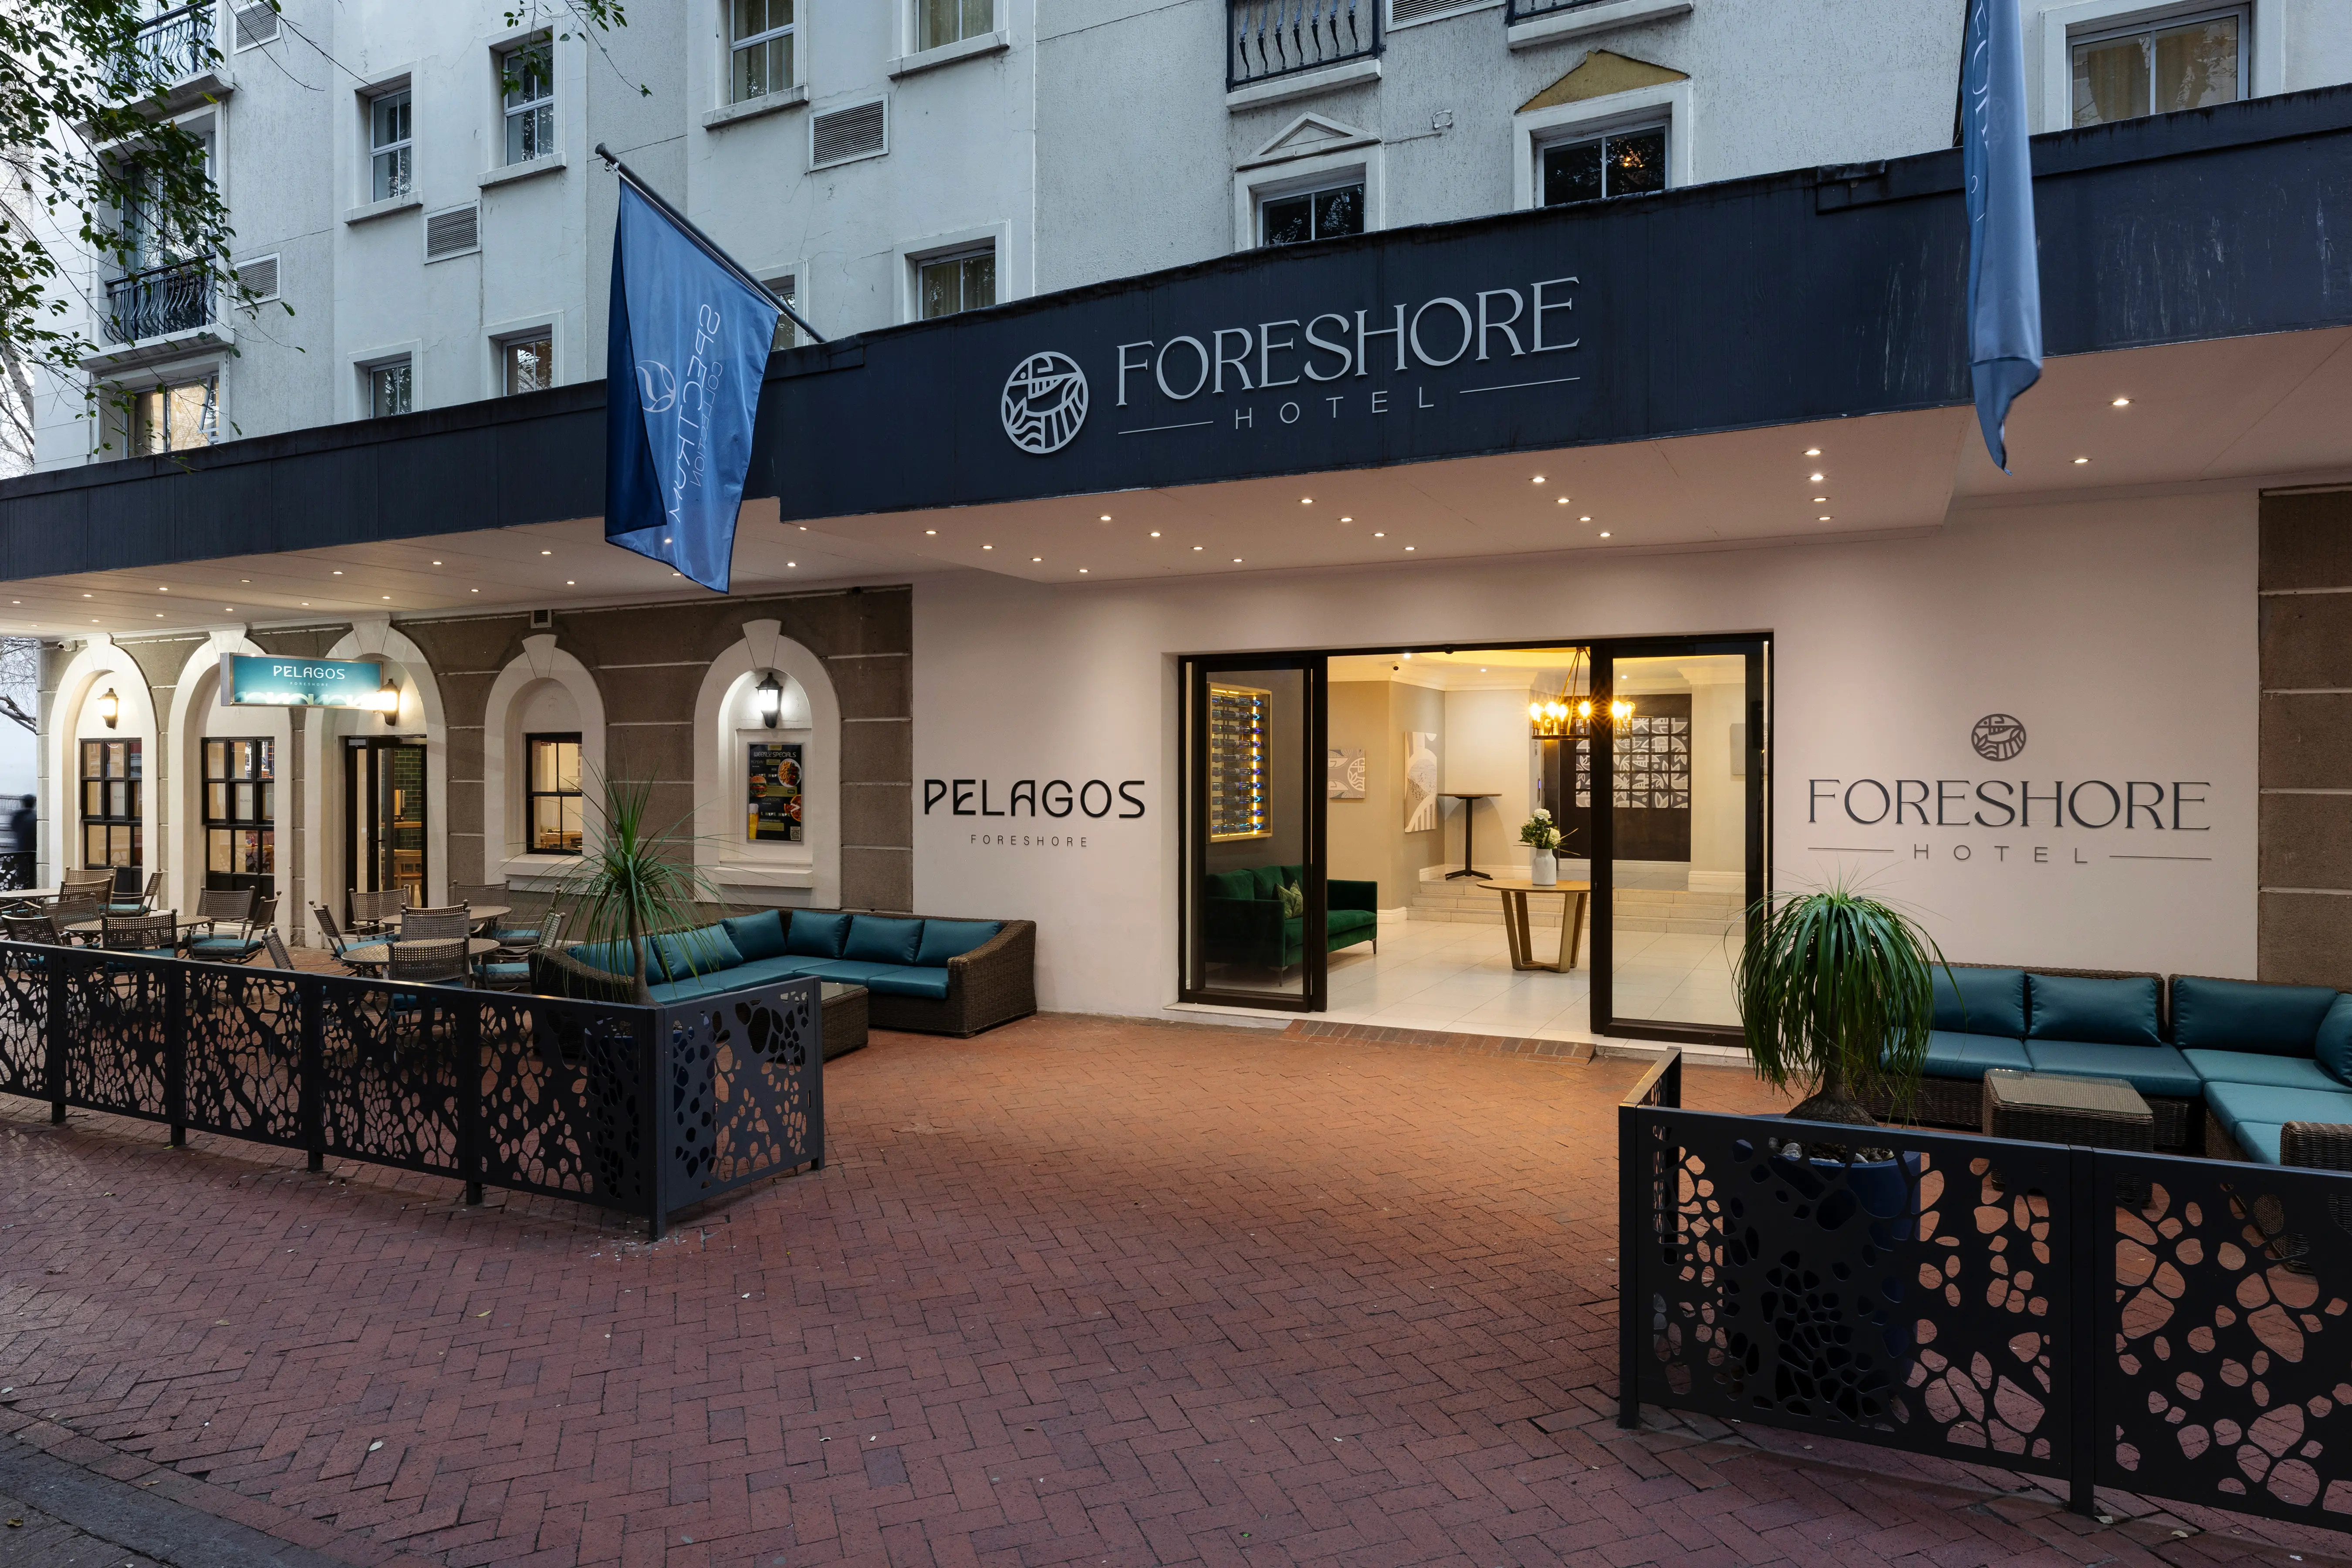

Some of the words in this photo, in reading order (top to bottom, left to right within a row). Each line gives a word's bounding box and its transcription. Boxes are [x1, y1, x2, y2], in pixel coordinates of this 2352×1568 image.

[1116, 276, 1580, 406] FORESHORE
[1235, 386, 1434, 429] HOTEL
[273, 665, 345, 679] PELAGOS
[924, 779, 1146, 819] PELAGOS
[1808, 779, 2211, 831] FORESHORE
[971, 834, 1087, 847] FORESHORE
[1914, 843, 2088, 864] HOTEL
